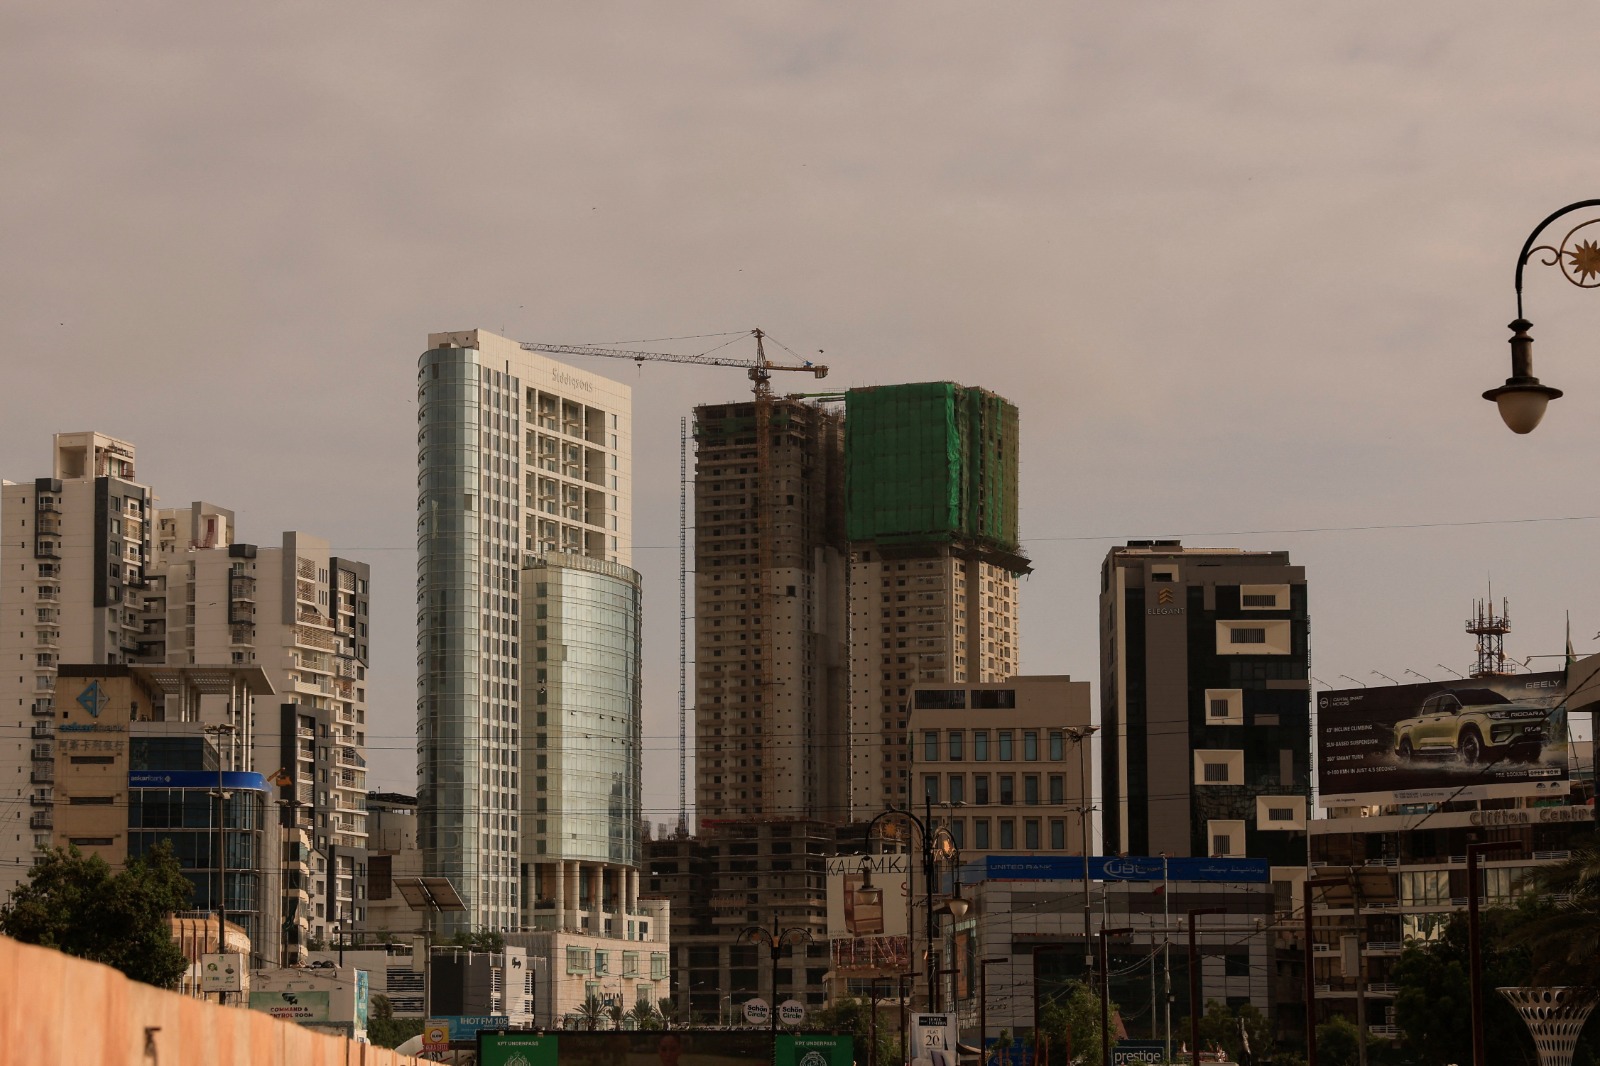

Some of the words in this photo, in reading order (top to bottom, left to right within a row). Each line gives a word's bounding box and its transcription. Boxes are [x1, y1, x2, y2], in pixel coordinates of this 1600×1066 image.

[1147, 607, 1185, 615] ELEGANT
[1525, 680, 1560, 689] GEELY
[1376, 765, 1397, 773] SECONDS
[130, 774, 164, 783] askaribank
[1469, 810, 1529, 826] Clifton
[827, 856, 907, 876] KALAMK
[747, 1004, 768, 1013] Schön
[481, 1017, 493, 1025] FM
[495, 1017, 508, 1025] 105
[925, 1034, 941, 1046] 20
[1114, 1050, 1161, 1064] prestige
